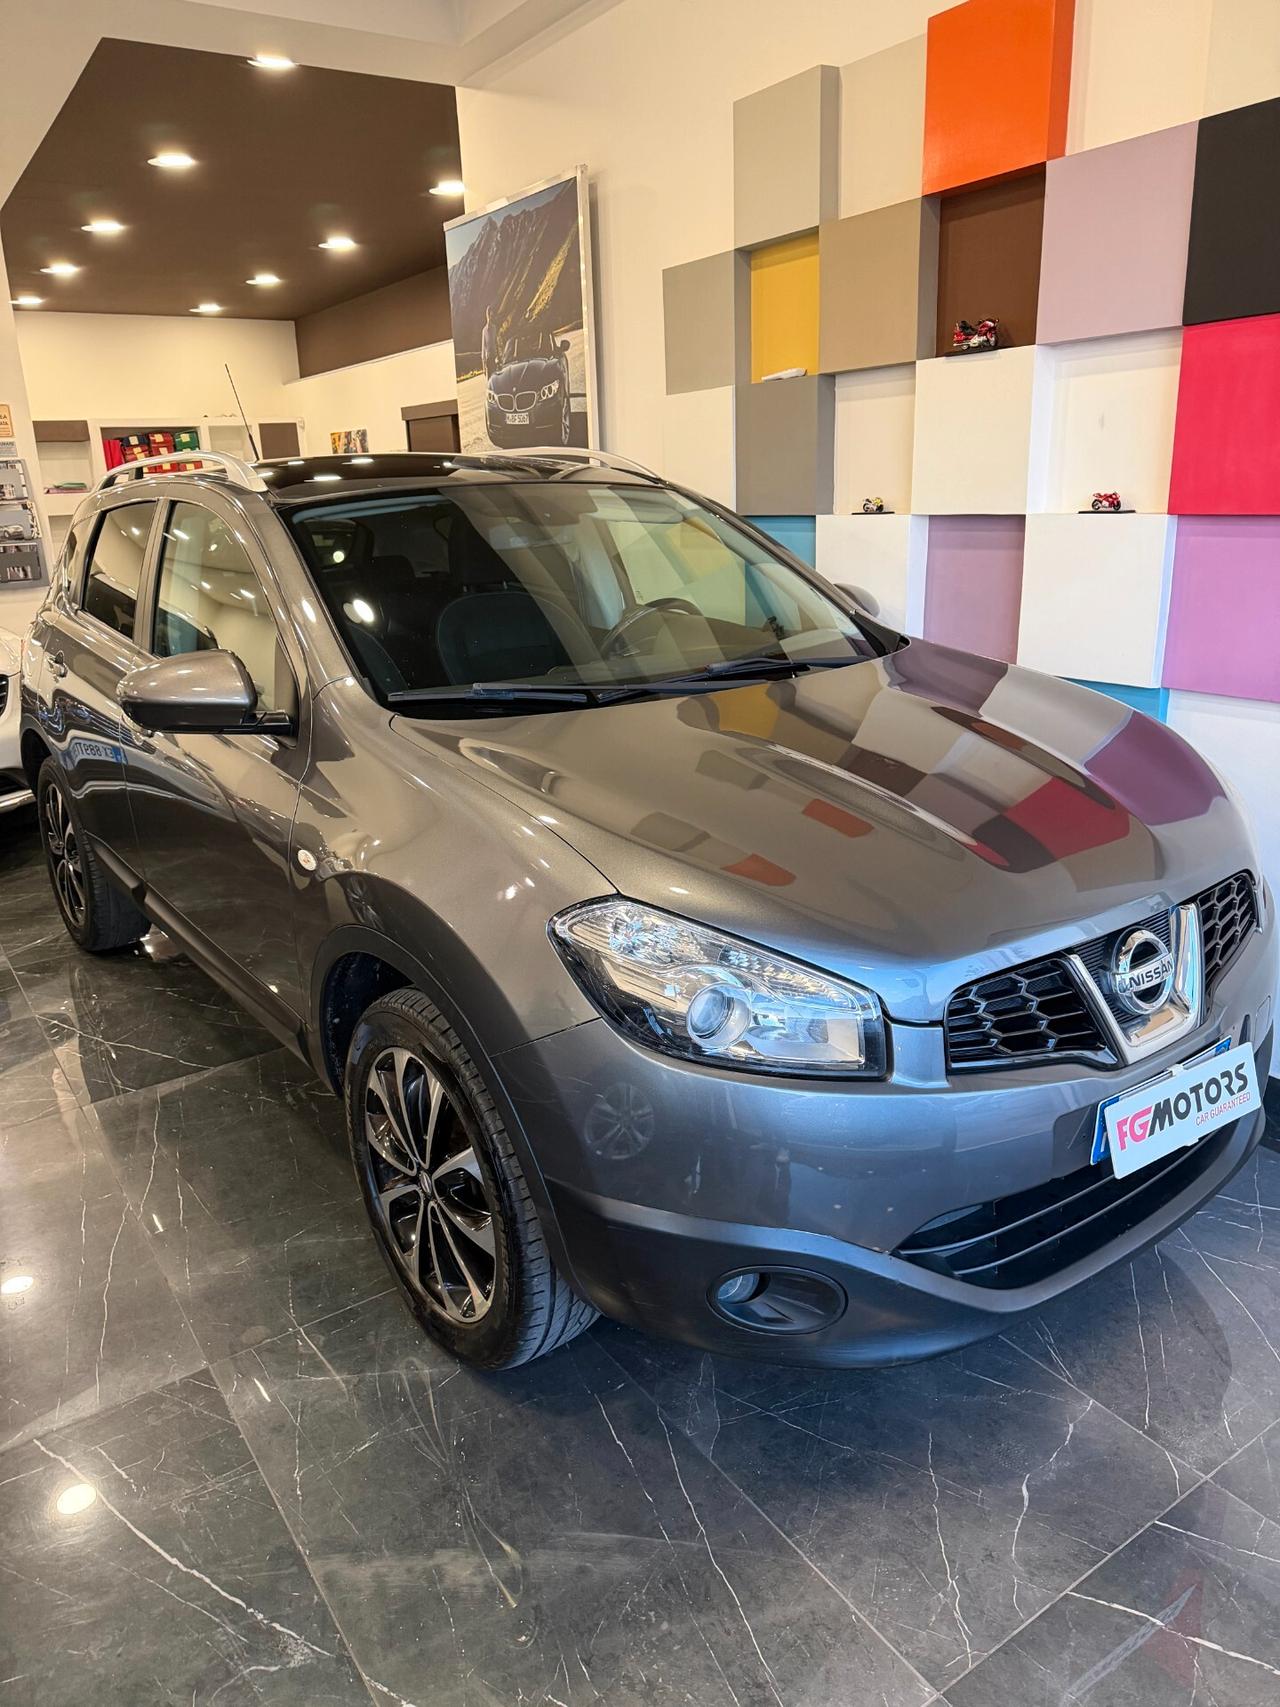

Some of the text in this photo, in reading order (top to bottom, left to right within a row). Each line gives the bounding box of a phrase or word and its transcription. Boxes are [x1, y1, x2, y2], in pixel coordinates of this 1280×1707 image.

[1128, 959, 1174, 988] NISSAN
[1195, 1091, 1251, 1127] CAR GUARANTEED
